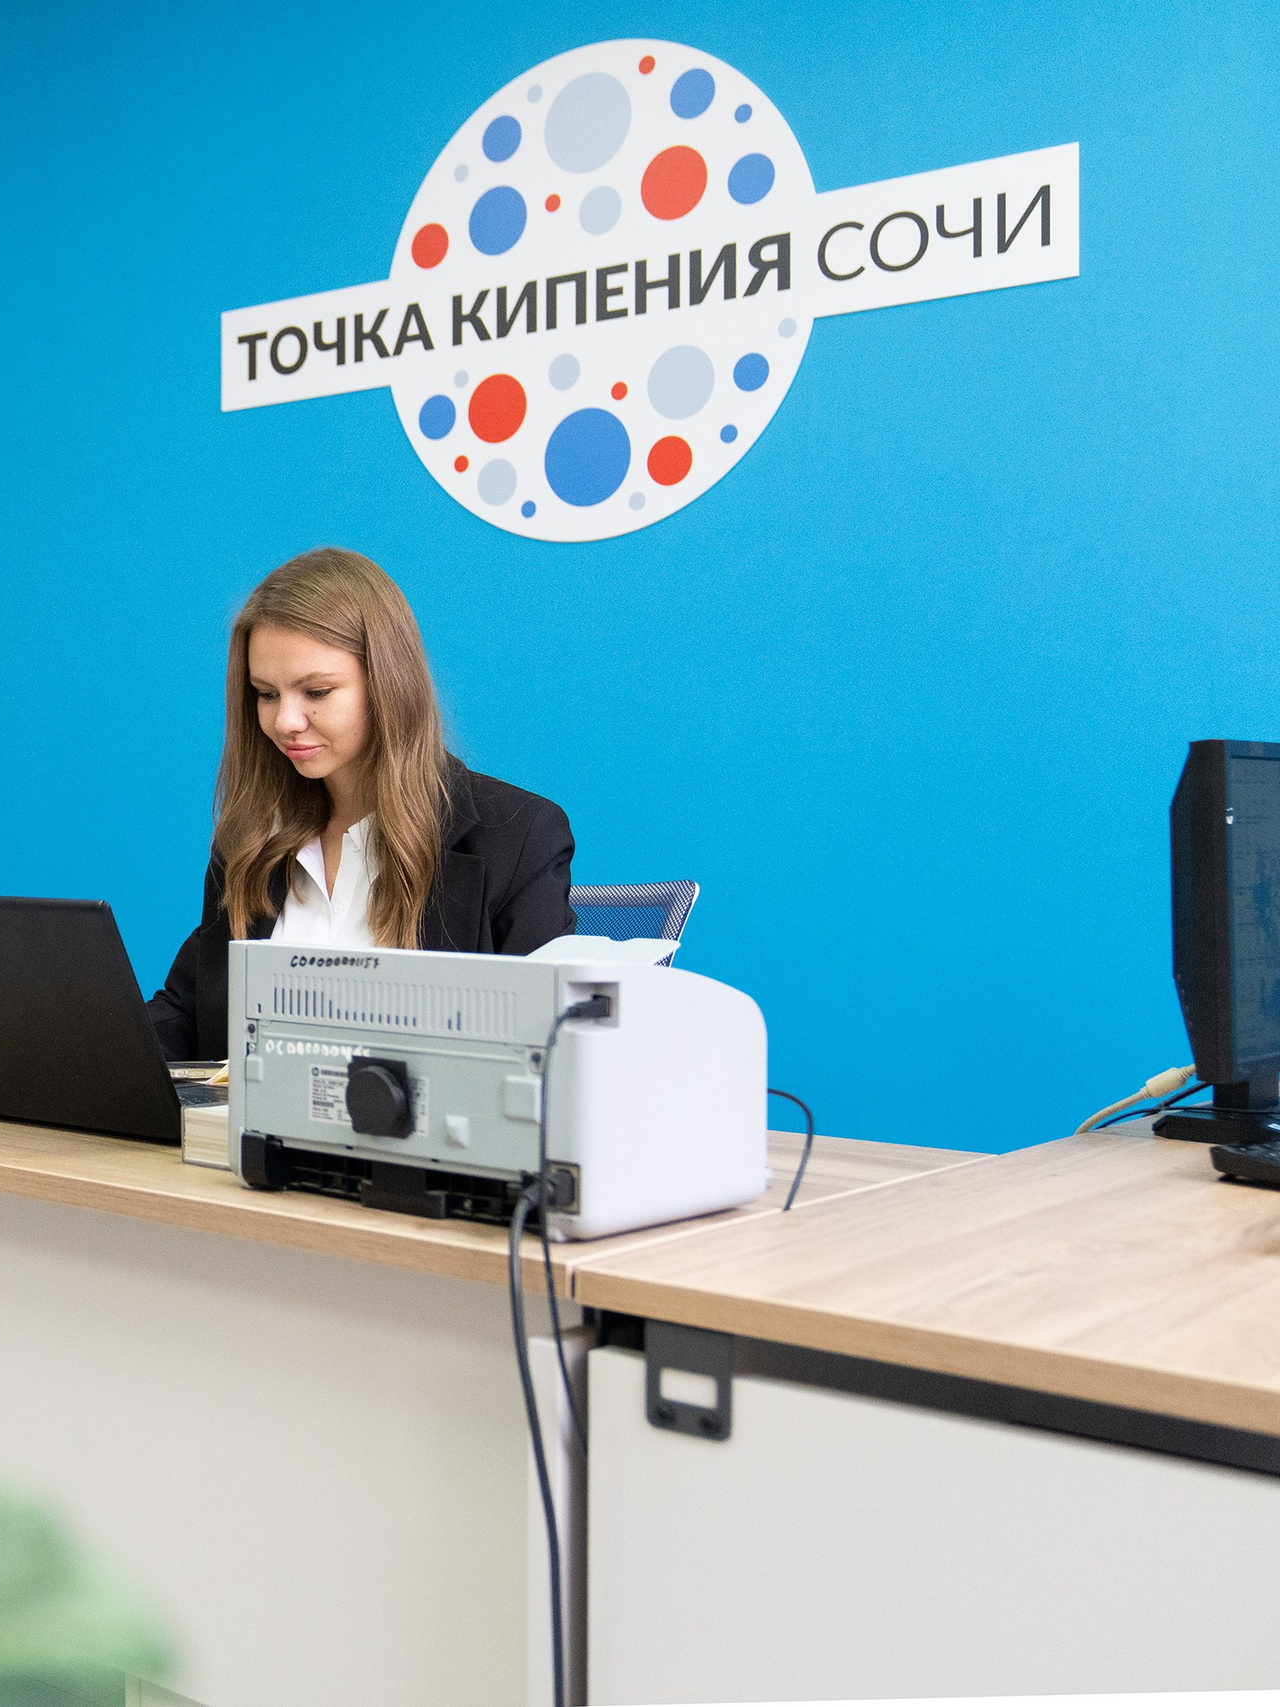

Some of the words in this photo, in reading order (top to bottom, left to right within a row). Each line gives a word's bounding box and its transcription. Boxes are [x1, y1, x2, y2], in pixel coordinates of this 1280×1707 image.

[237, 302, 435, 381] ТОЧКА
[452, 232, 791, 347] КИПЕНИЯ
[817, 184, 1051, 281] СОЧИ
